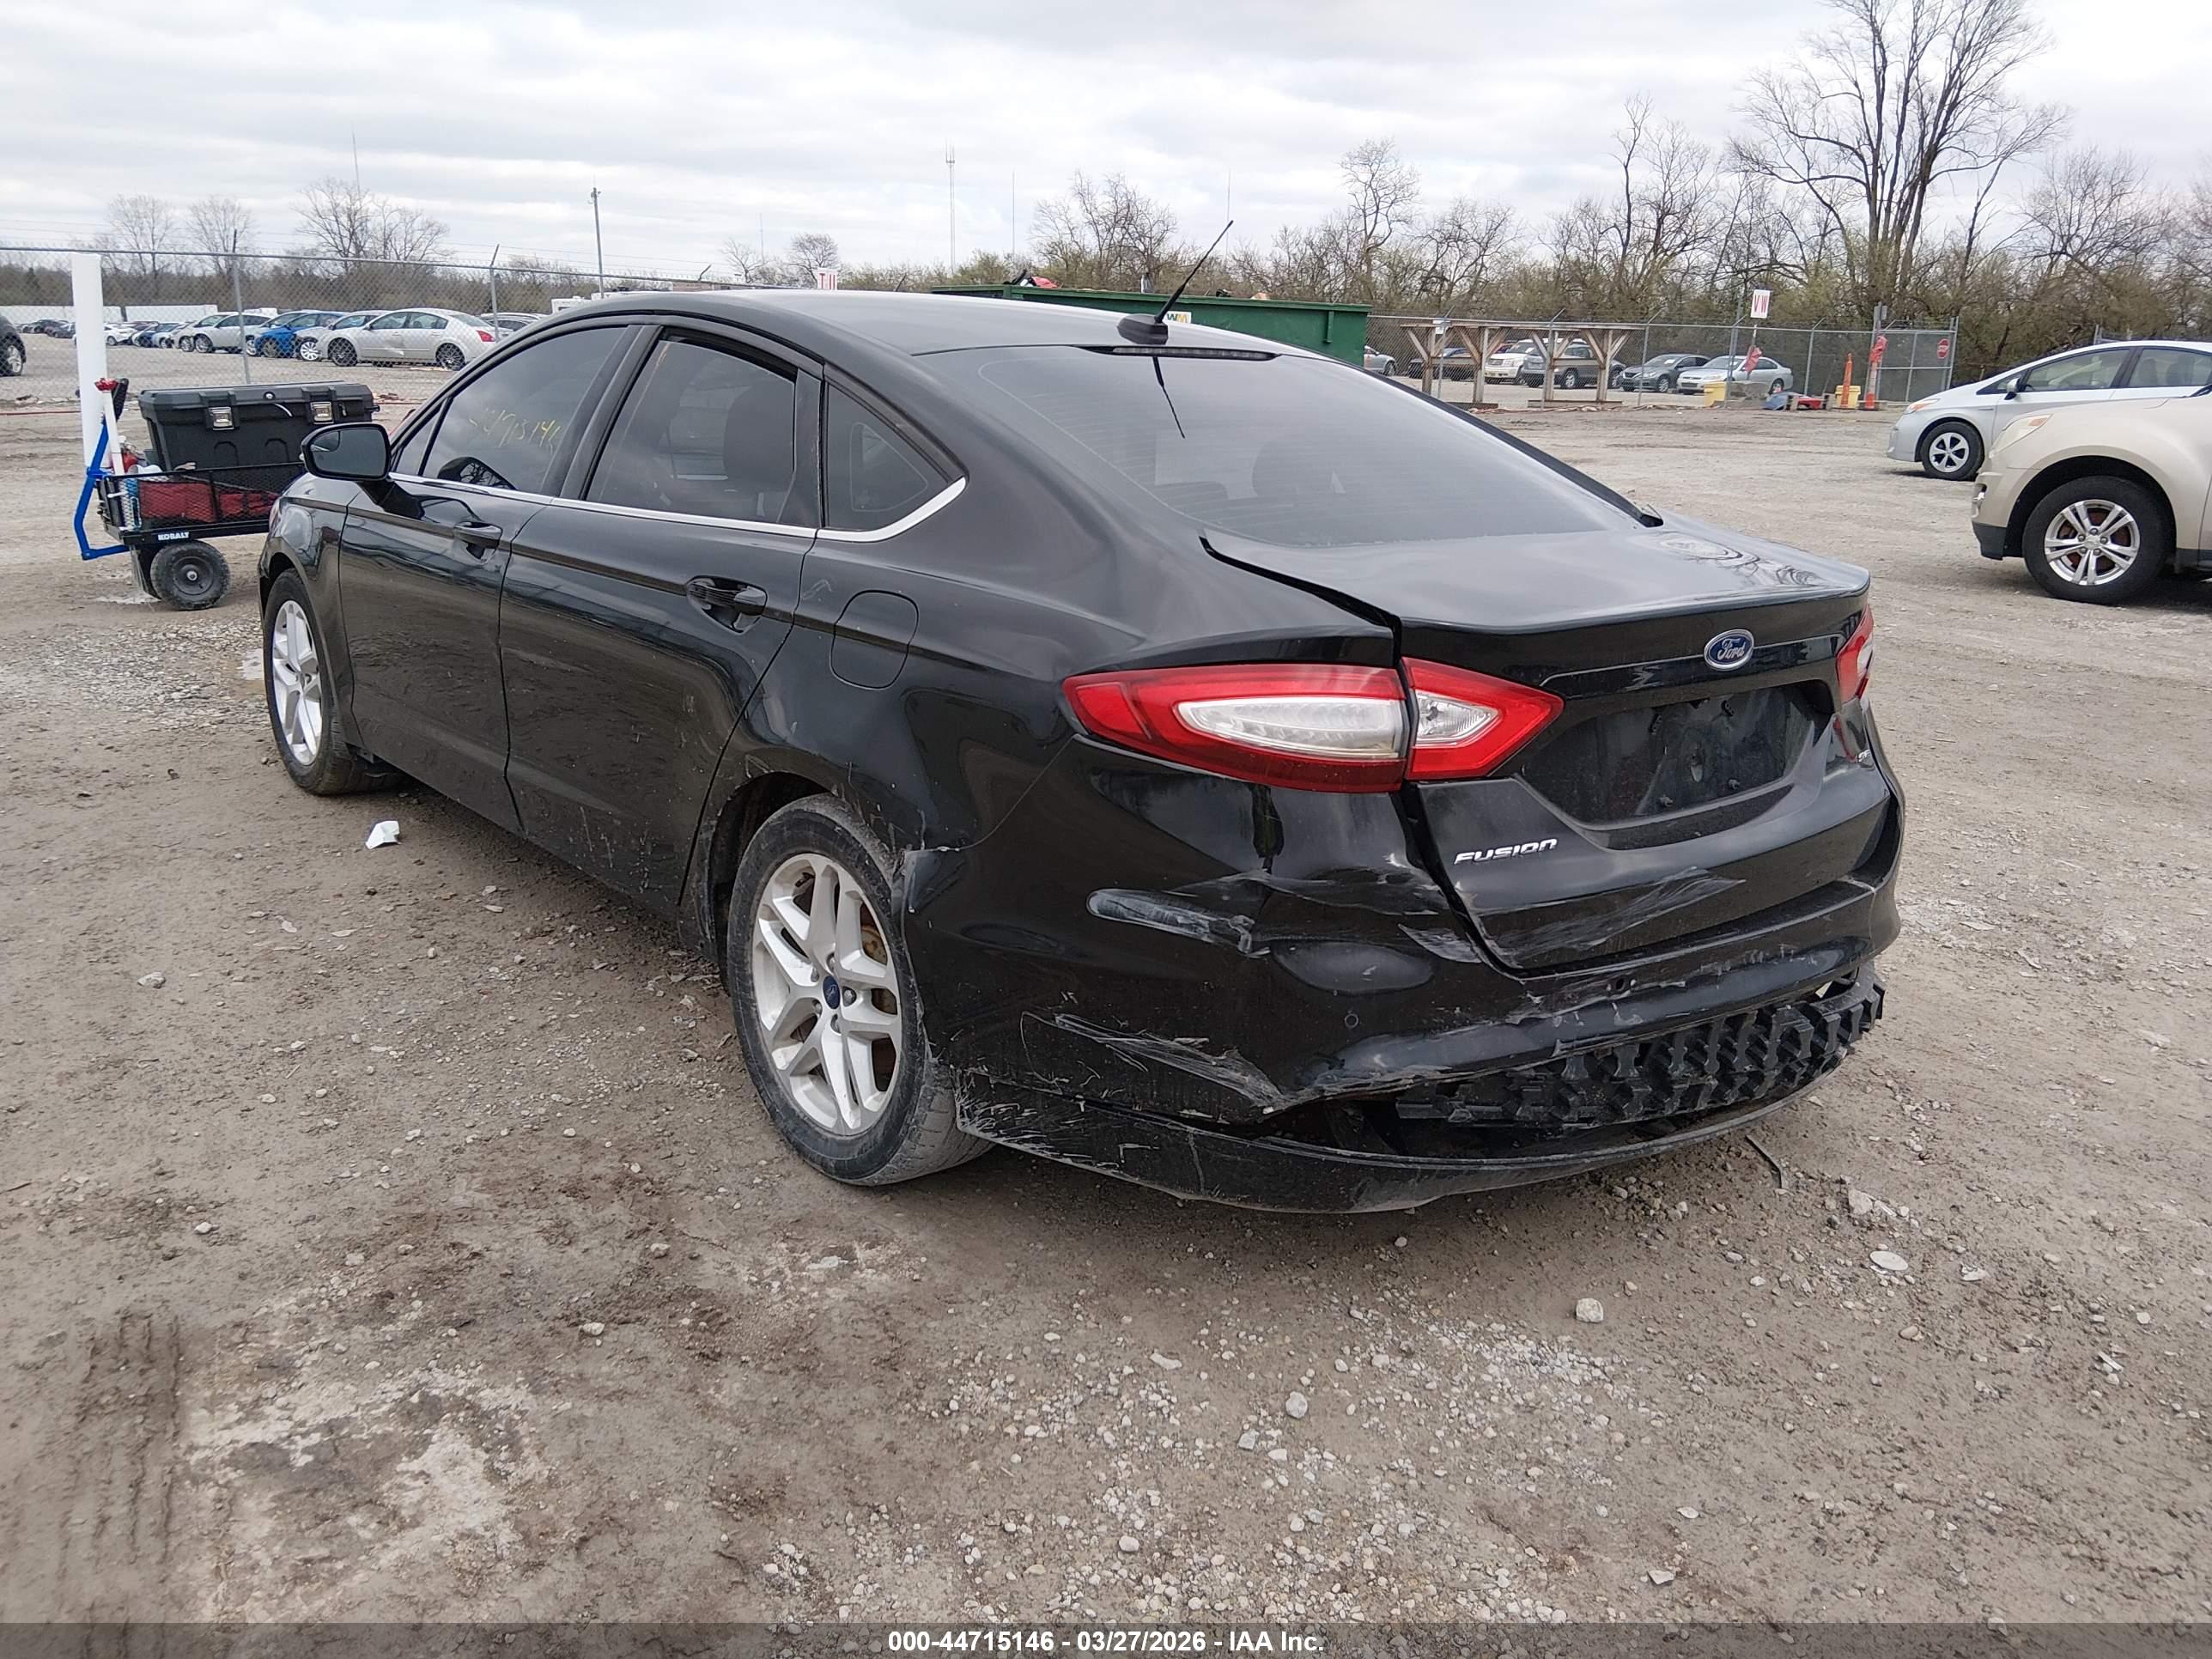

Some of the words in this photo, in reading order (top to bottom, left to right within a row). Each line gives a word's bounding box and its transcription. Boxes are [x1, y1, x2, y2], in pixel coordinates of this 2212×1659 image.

[157, 532, 190, 541] KOBALT
[1717, 637, 1747, 660] Ford
[1453, 838, 1558, 865] FUSION
